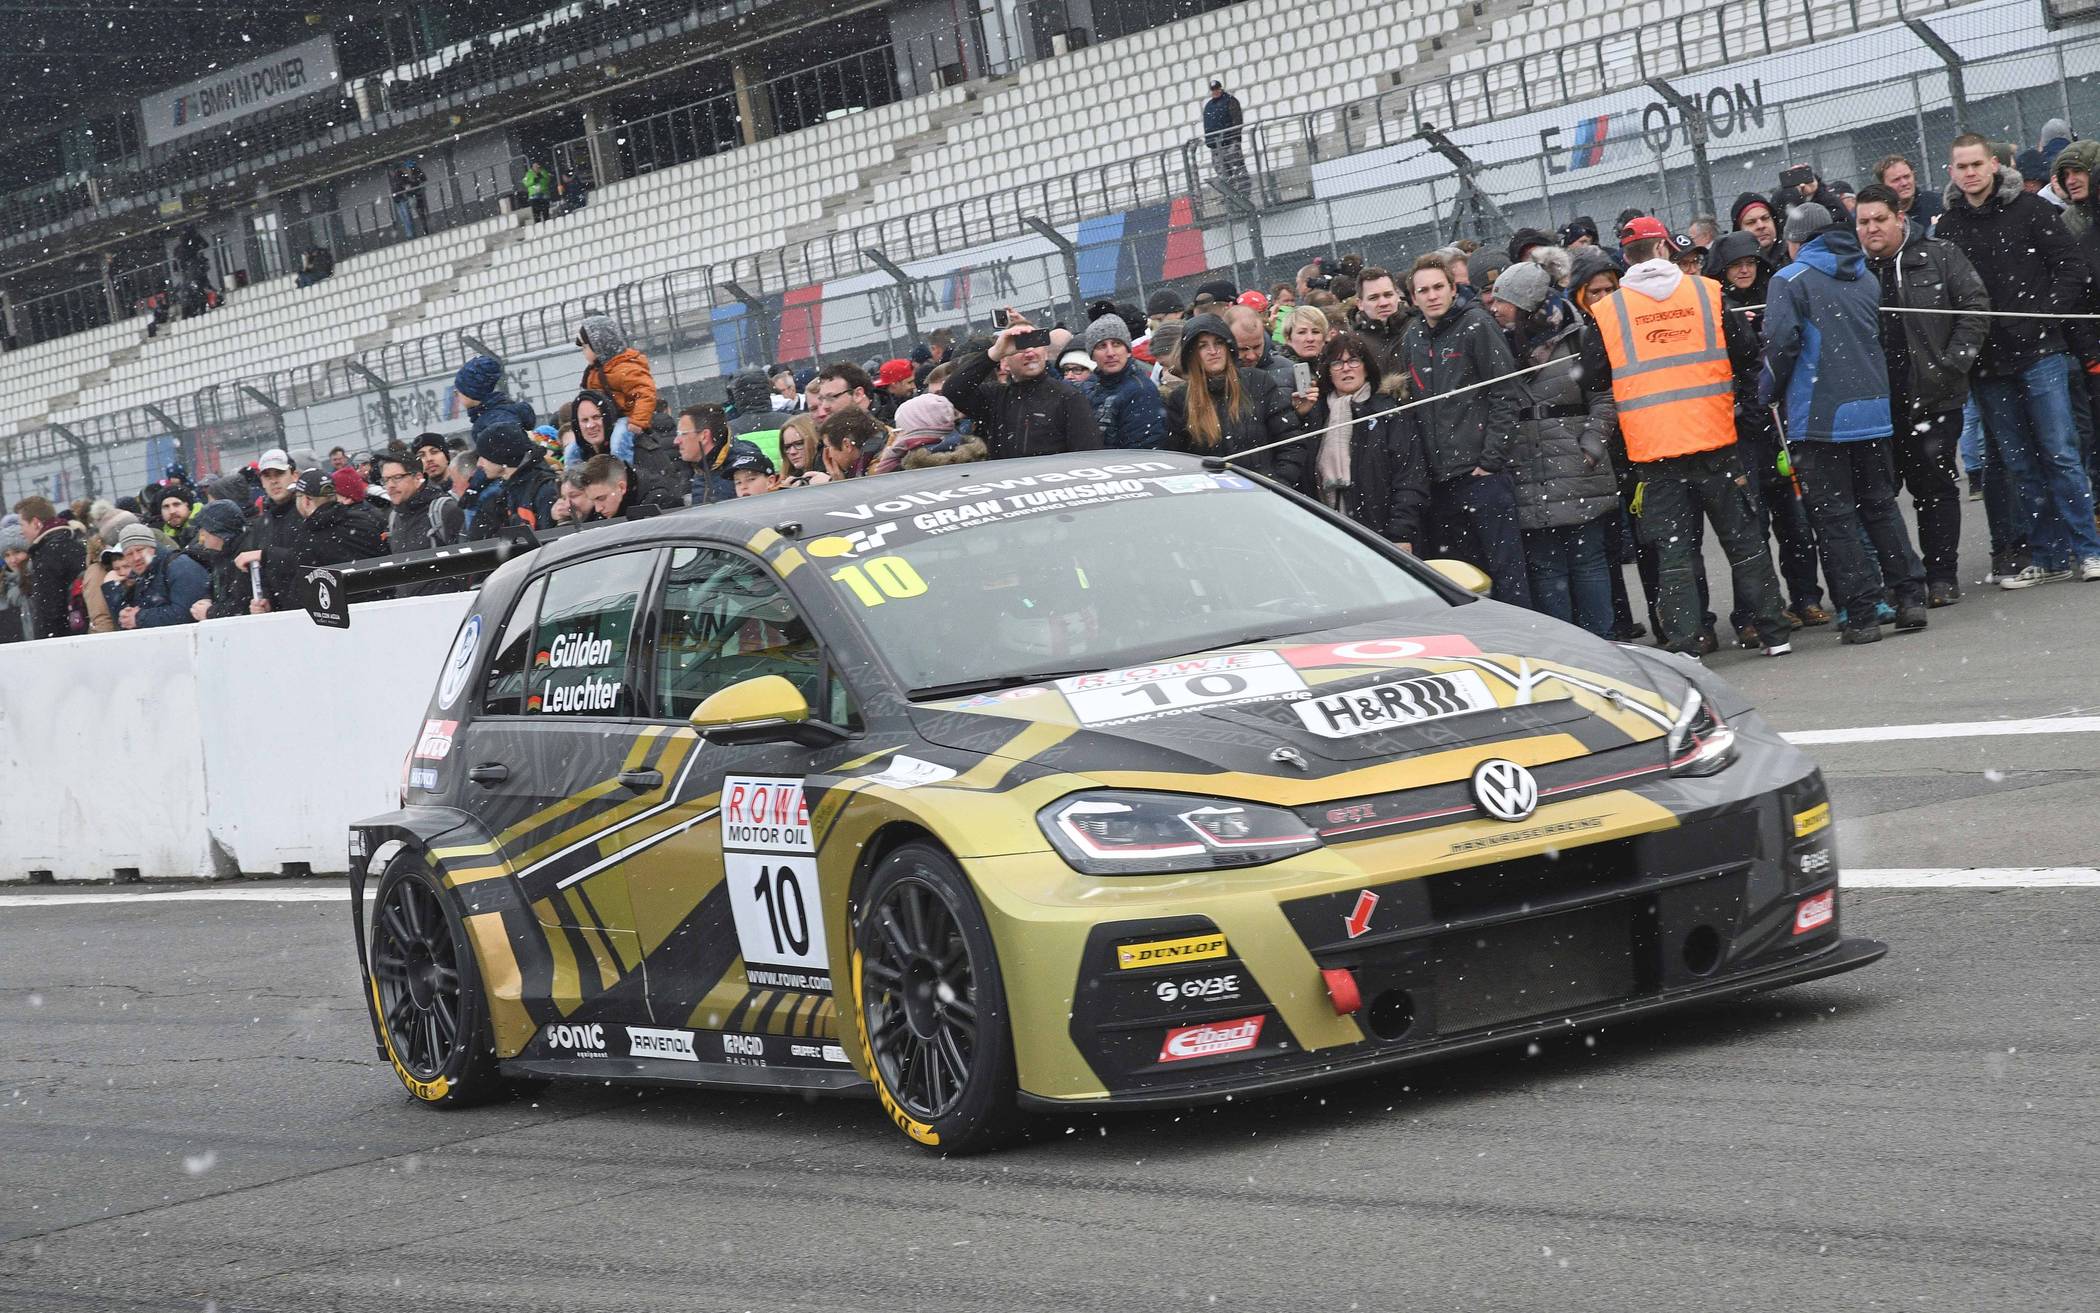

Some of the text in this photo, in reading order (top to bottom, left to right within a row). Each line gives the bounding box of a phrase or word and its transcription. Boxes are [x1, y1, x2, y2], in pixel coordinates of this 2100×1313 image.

[201, 82, 237, 117] BMW
[250, 57, 307, 100] POWER
[824, 462, 1177, 520] Volkswagen
[912, 500, 1003, 530] GRAN
[1004, 479, 1145, 509] TURISMO
[925, 492, 1154, 535] THE REAL DRIVING SIMULATOR
[830, 556, 928, 608] 10
[549, 632, 612, 668] Gülden
[1073, 656, 1251, 685] ROWE
[542, 676, 621, 713] Leuchter
[1121, 673, 1248, 706] 10
[729, 786, 809, 826] ROWE
[1326, 803, 1377, 823] GTI
[728, 825, 807, 844] MOTOR OIL
[753, 865, 809, 957] 10
[1139, 940, 1223, 960] DUNLOP
[634, 1035, 692, 1054] RAVENOL
[1167, 1021, 1258, 1056] Eibach
[726, 1056, 767, 1068] RACING
